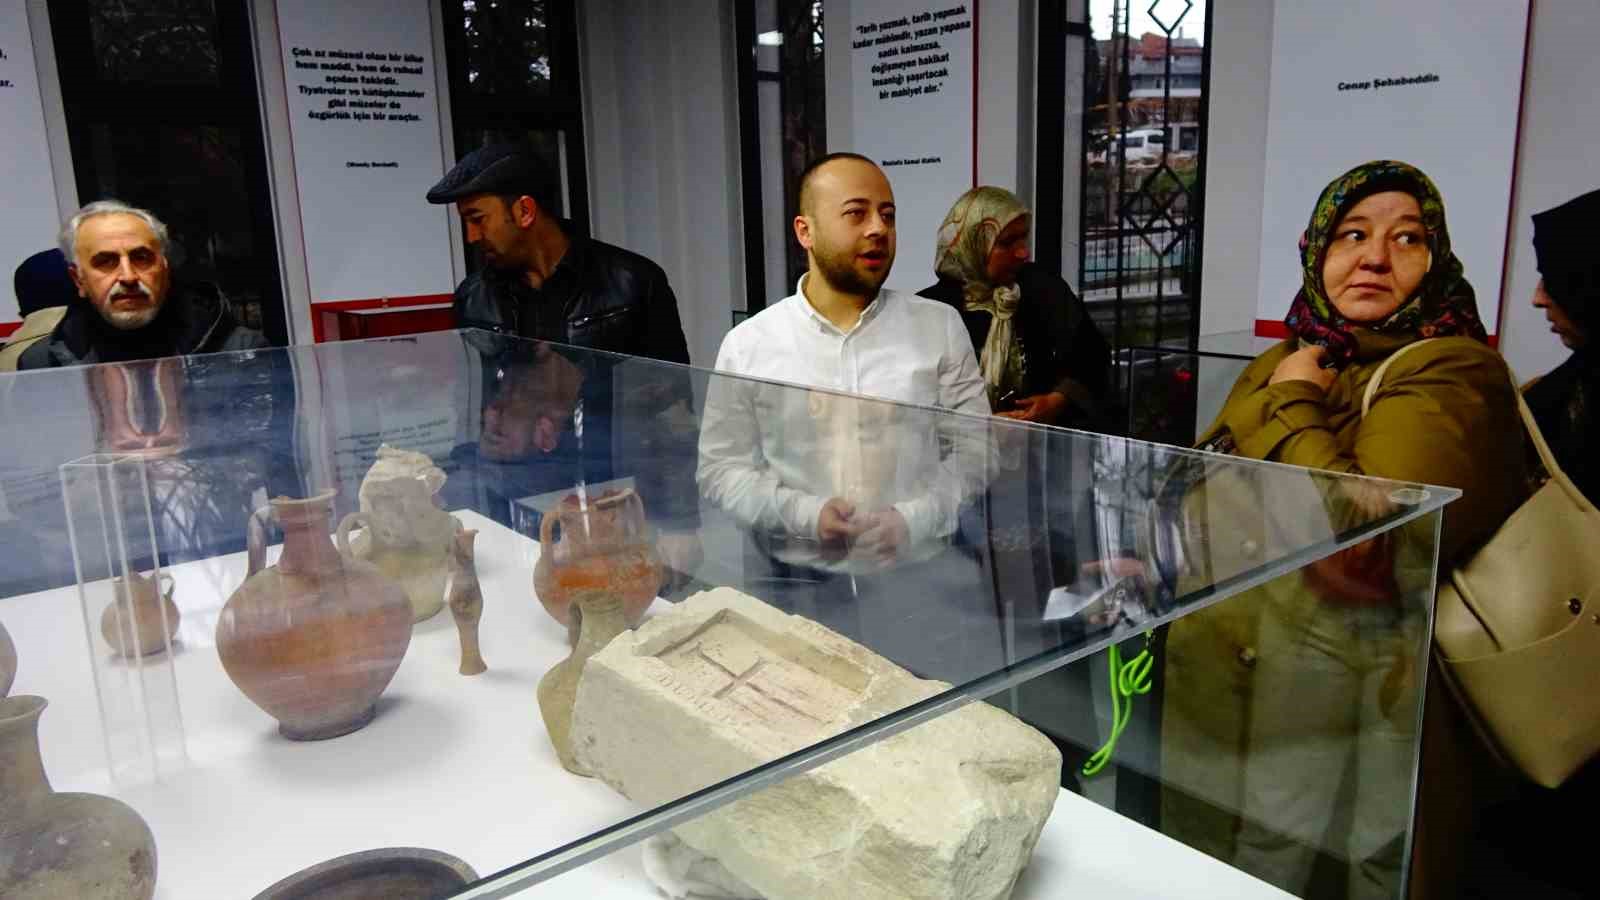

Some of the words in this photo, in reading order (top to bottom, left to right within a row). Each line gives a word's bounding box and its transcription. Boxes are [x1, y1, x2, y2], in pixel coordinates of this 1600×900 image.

[912, 12, 931, 24] tarih
[933, 5, 966, 21] yapmak
[853, 39, 873, 49] kadar
[914, 27, 938, 39] yazan
[940, 21, 971, 35] yapana
[292, 47, 311, 58] Çok
[366, 51, 386, 60] olan
[389, 52, 401, 61] bir
[918, 53, 949, 66] hakikat
[296, 60, 318, 69] hem
[356, 63, 377, 72] hem
[380, 64, 392, 73] de
[880, 90, 889, 99] bir
[891, 86, 922, 97] mahiyet
[1338, 82, 1371, 91] Cenap
[373, 112, 386, 120] bir
